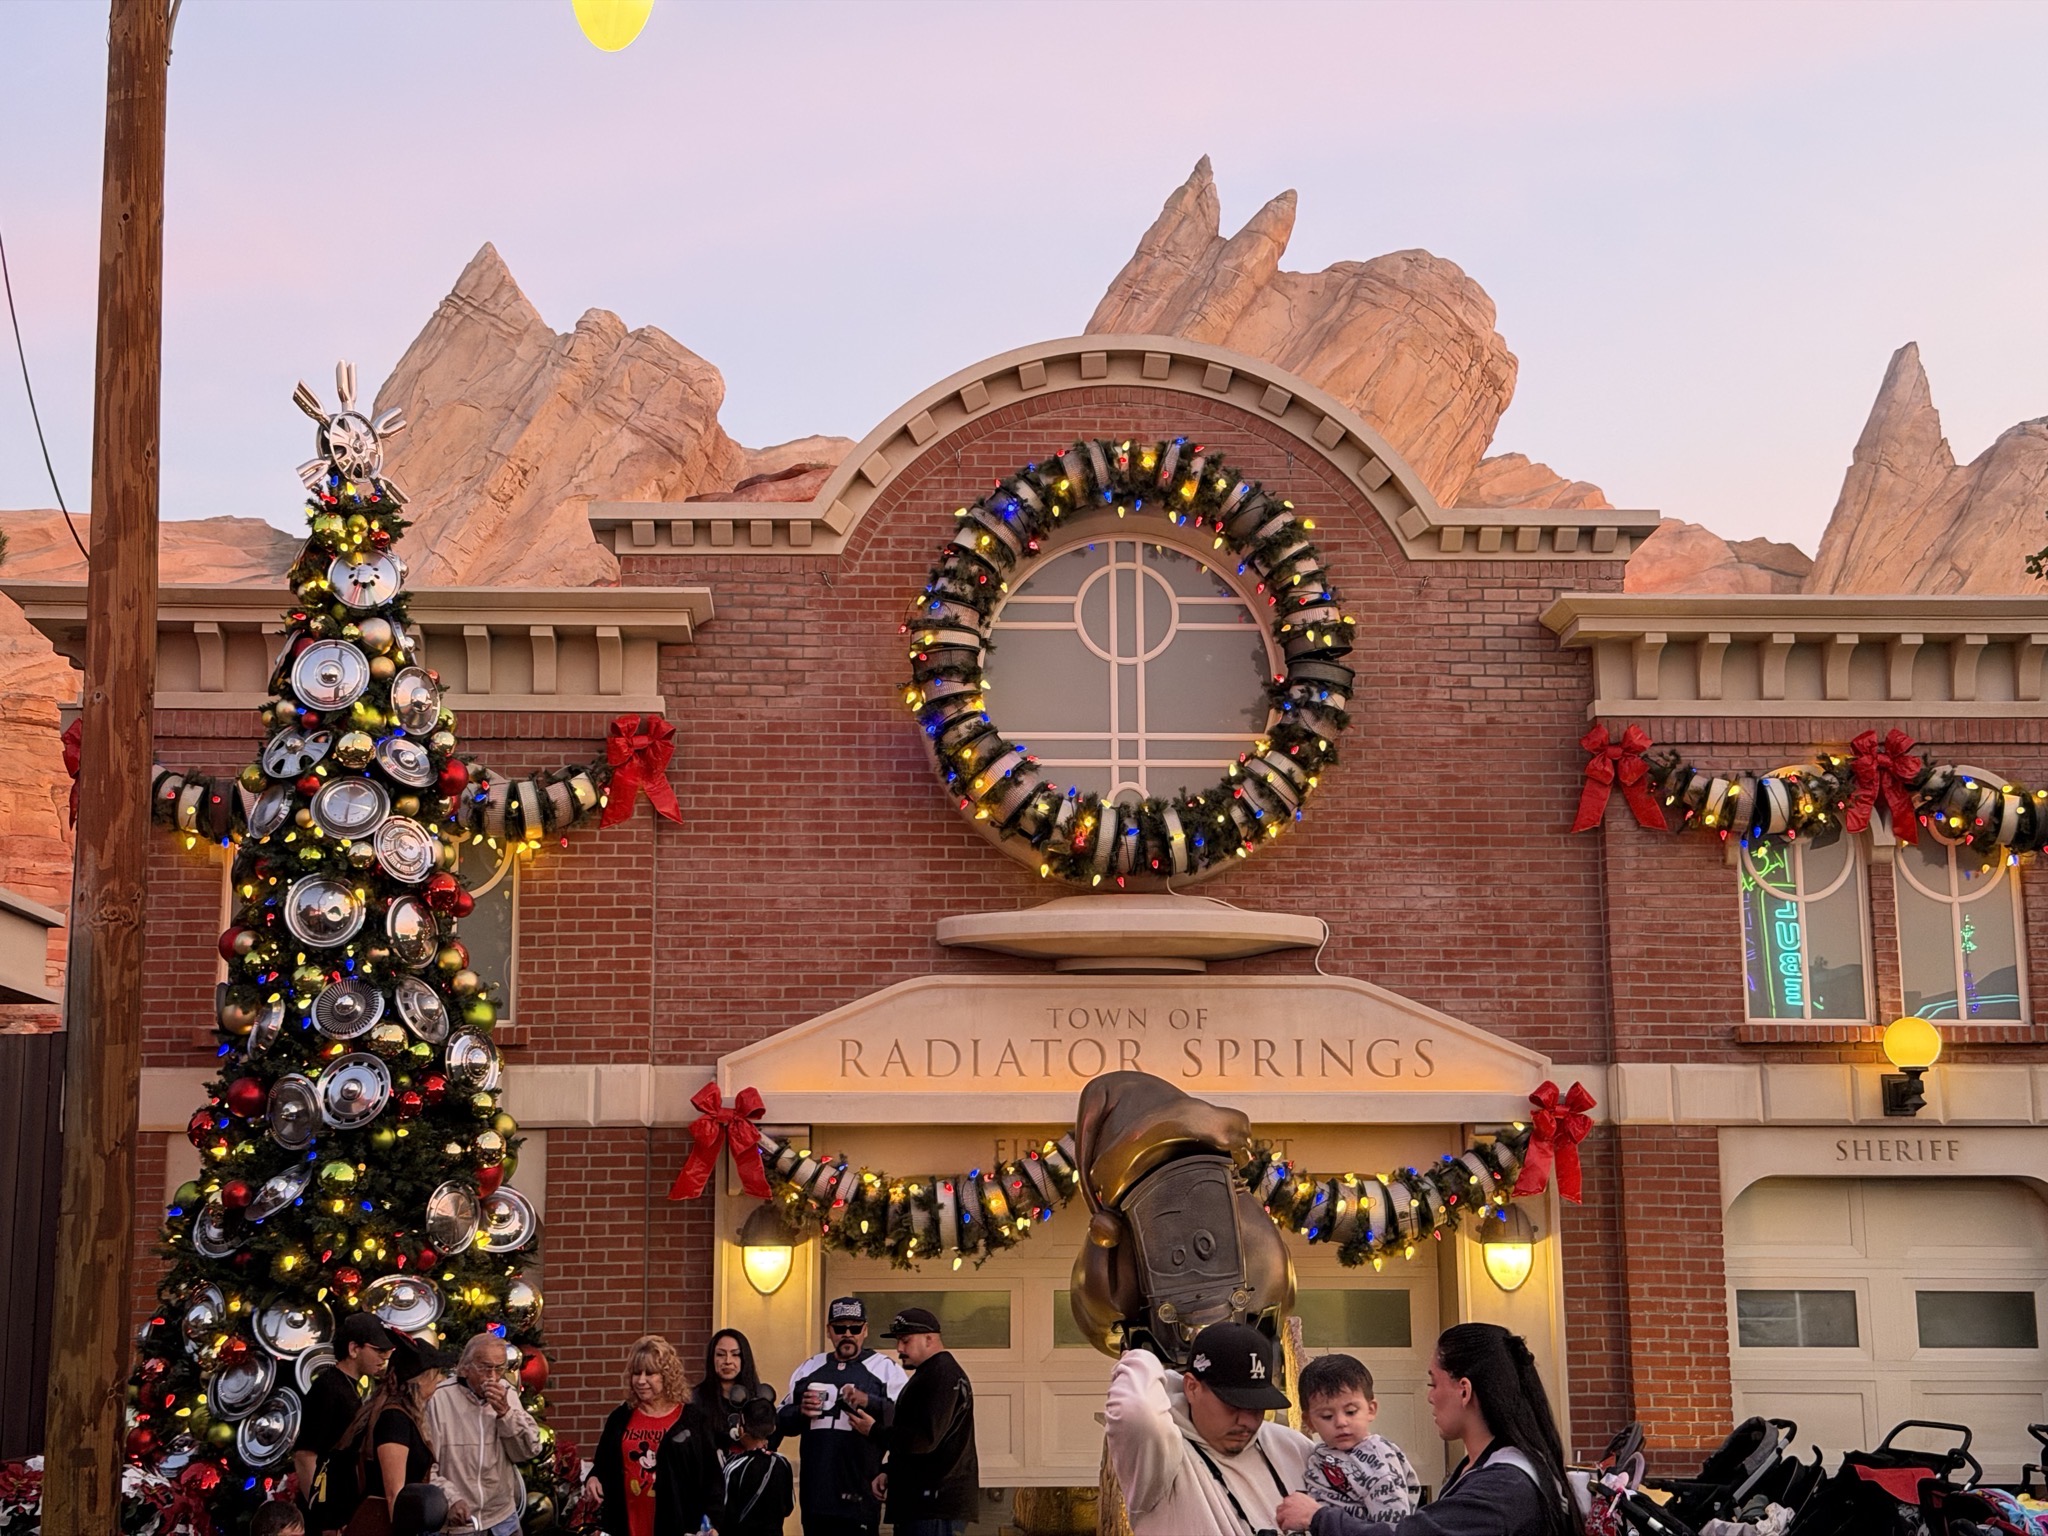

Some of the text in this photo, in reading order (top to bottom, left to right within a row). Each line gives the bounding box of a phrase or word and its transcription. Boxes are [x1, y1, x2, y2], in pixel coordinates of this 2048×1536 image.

[1046, 1007, 1209, 1030] TOWN OF
[839, 1038, 1435, 1078] RADIATOR SPRINGS
[1836, 1139, 1960, 1161] SHERIFF
[1249, 1352, 1266, 1379] LA
